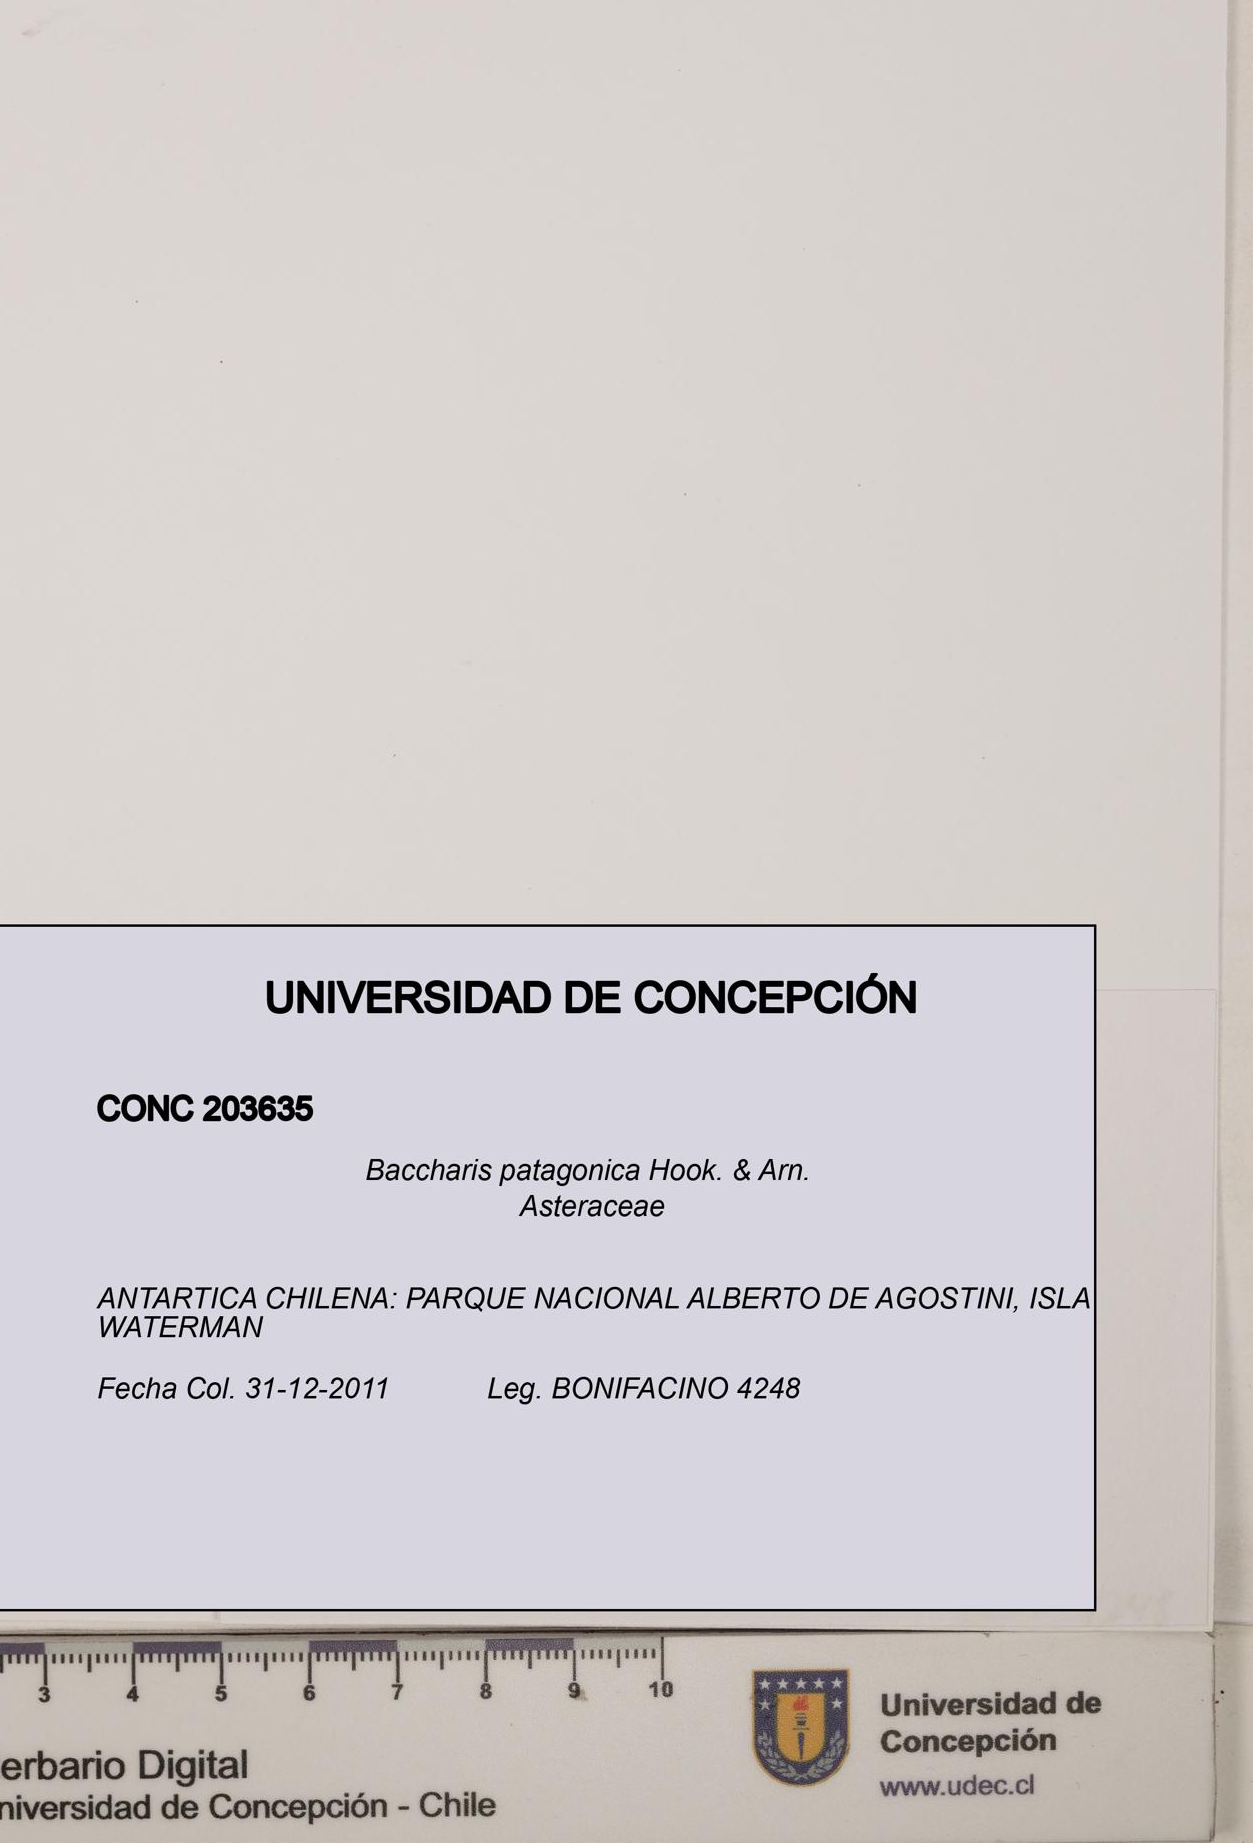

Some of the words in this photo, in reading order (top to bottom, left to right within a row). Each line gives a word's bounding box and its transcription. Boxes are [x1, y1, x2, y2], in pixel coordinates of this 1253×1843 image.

[38, 1684, 51, 1703] 3
[126, 1684, 140, 1703] 4
[214, 1683, 228, 1702] 5
[303, 1683, 316, 1702] 6
[391, 1682, 404, 1701] 7
[479, 1682, 493, 1700] 8
[567, 1681, 582, 1700] 9
[648, 1680, 674, 1698] 10
[881, 1690, 1057, 1717] Universidad
[1065, 1690, 1102, 1715] de
[880, 1727, 1057, 1758] Concepción
[138, 1748, 248, 1788] Digital
[879, 1773, 1035, 1797] www.udec.cl
[160, 1793, 199, 1820] de
[208, 1792, 388, 1825] Concepción
[419, 1791, 497, 1818] Chile
